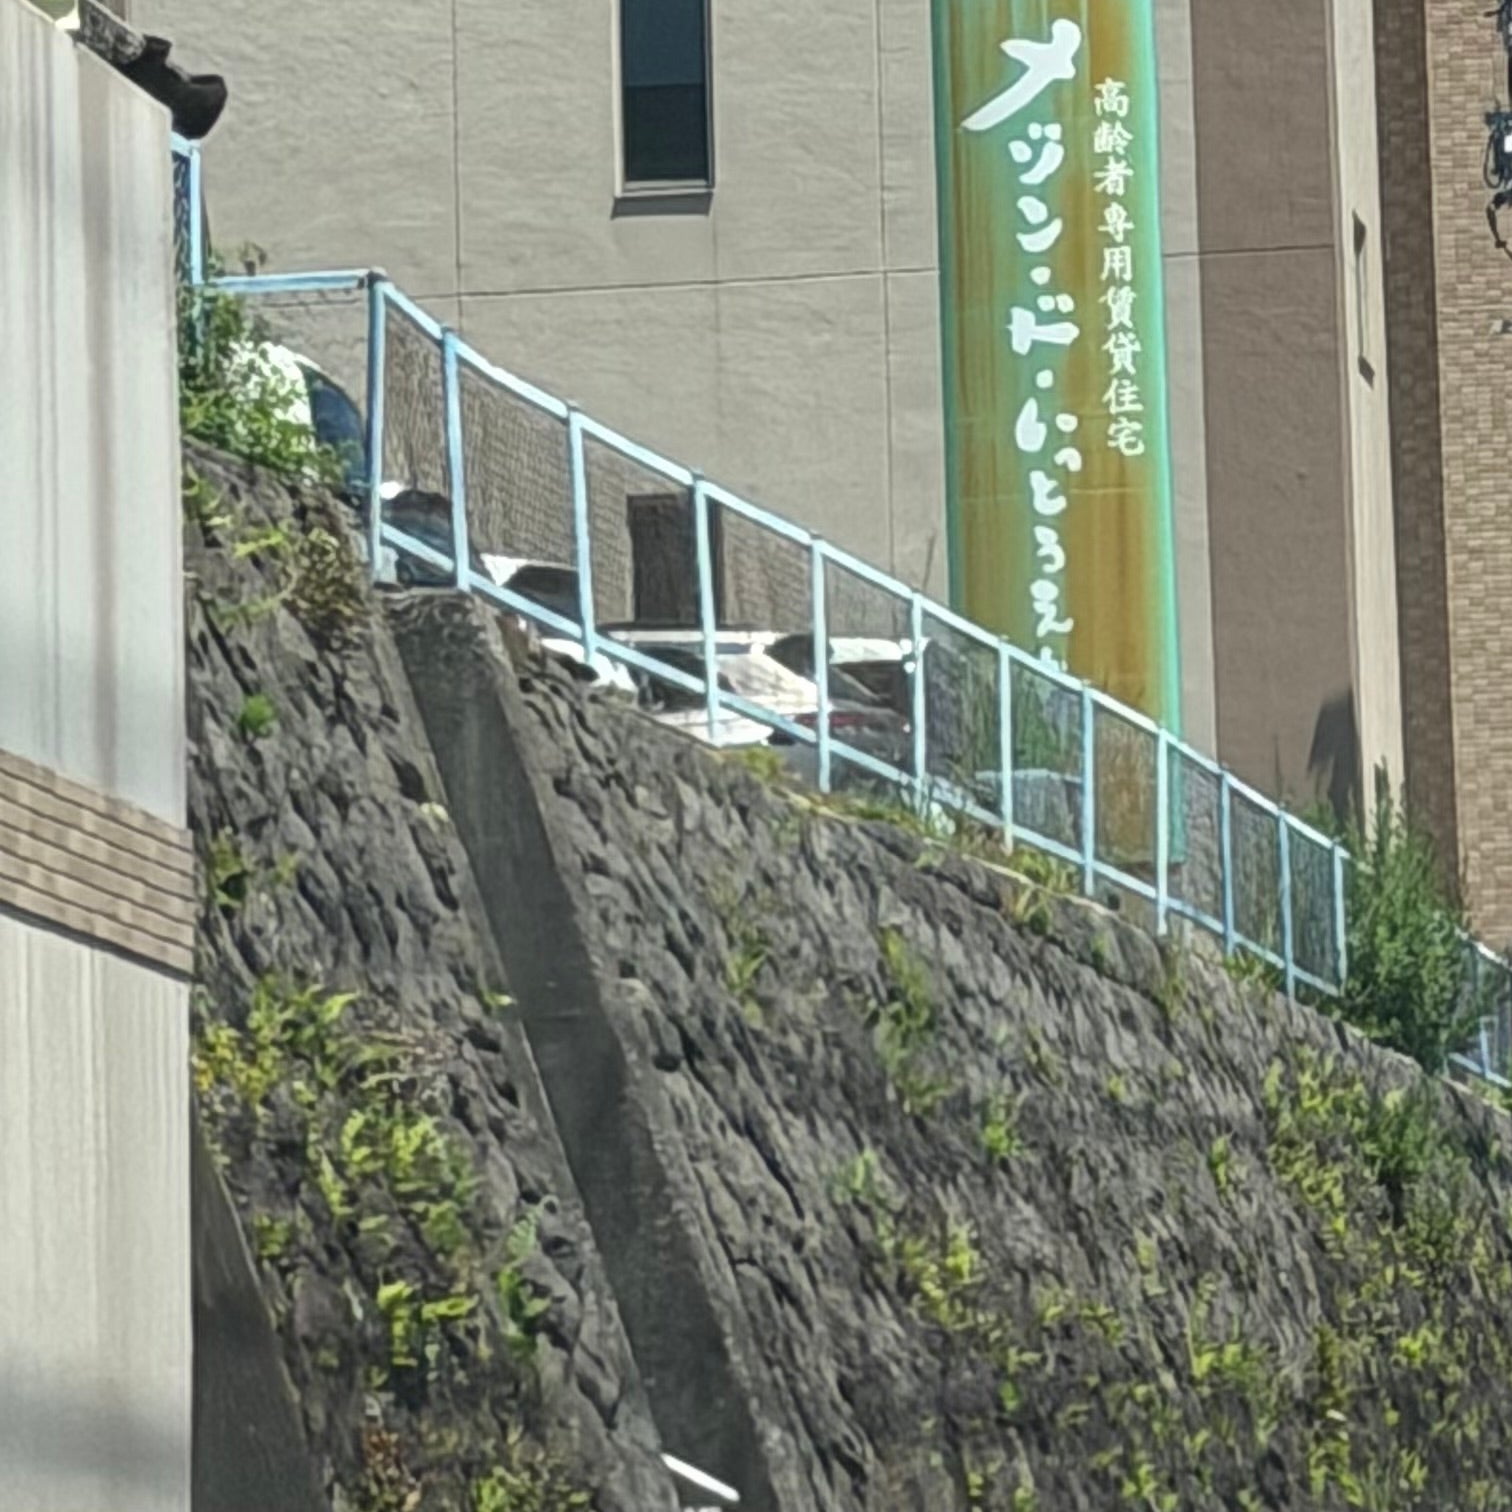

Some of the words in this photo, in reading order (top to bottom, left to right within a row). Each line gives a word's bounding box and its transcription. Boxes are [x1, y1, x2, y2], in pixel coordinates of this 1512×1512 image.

[1093, 77, 1145, 456] 高齢者専用賃貸住宅
